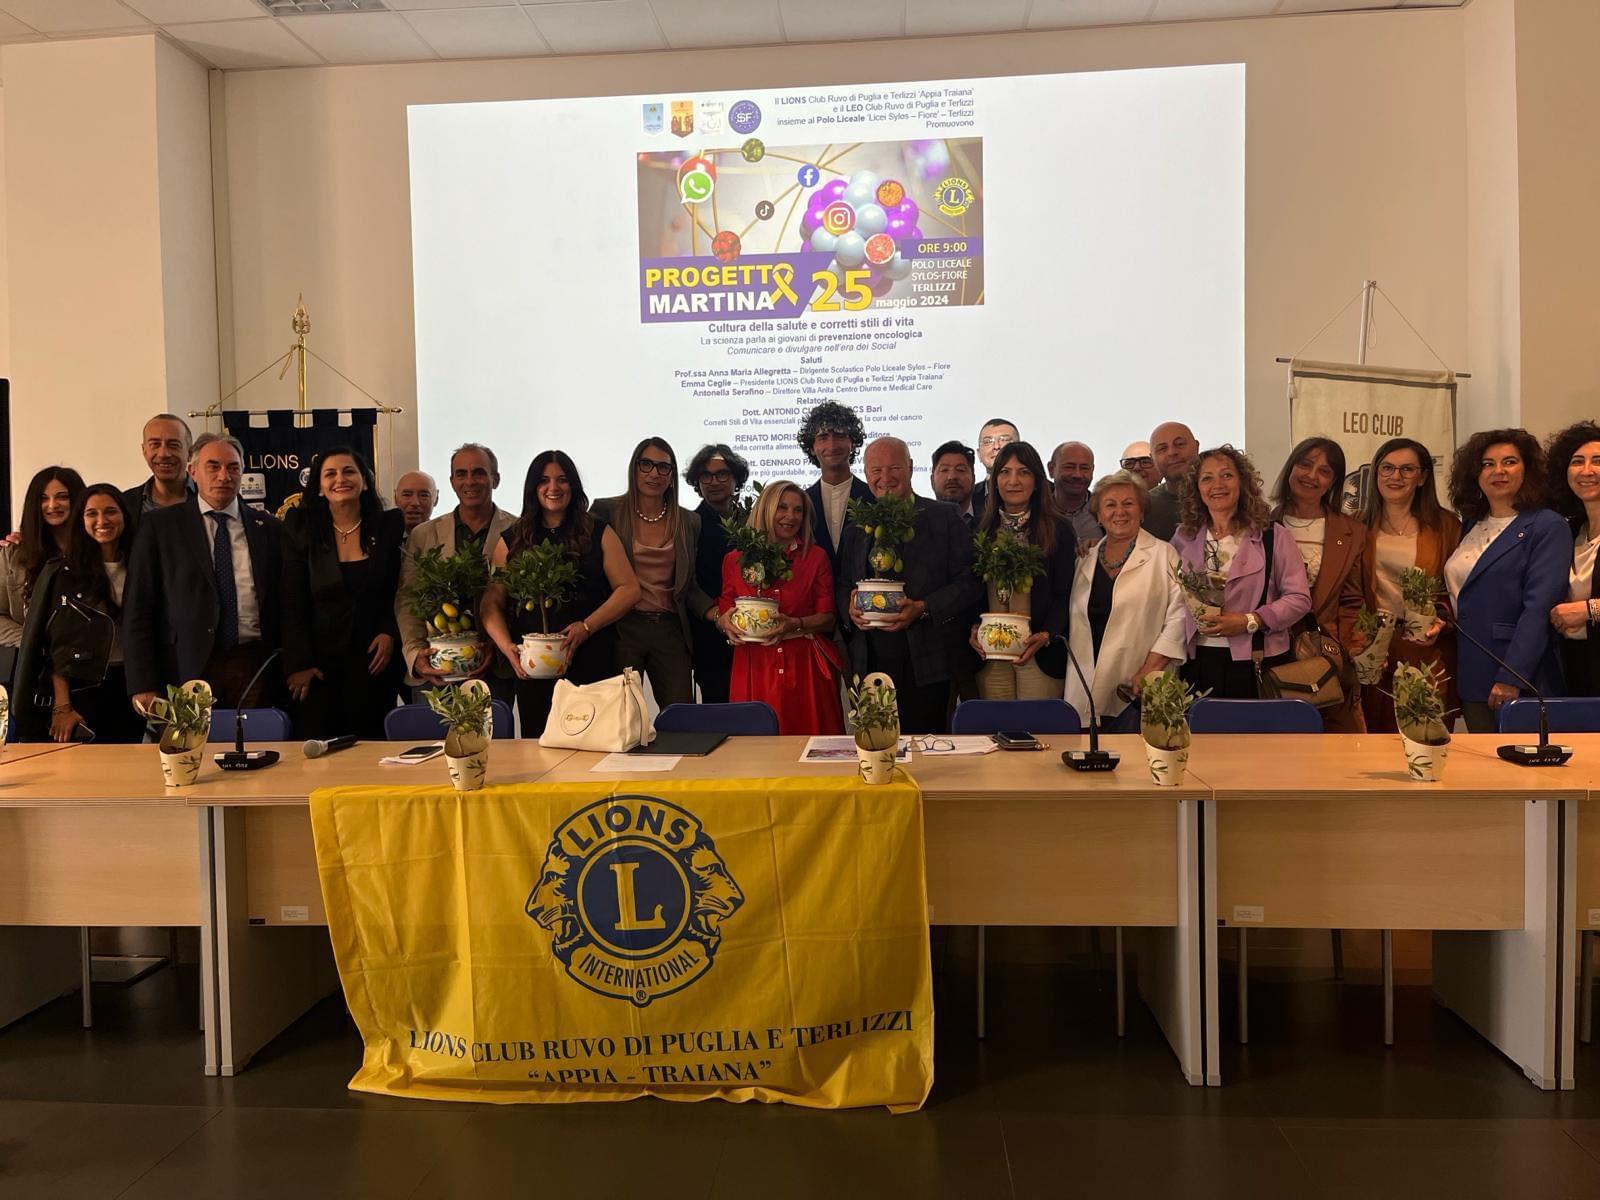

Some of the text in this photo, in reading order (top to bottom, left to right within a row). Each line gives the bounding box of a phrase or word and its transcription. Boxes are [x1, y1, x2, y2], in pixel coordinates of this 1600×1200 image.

[781, 97, 807, 105] LIONS
[809, 95, 826, 103] Club
[828, 95, 848, 103] Ruvo
[849, 94, 857, 102] di
[858, 93, 882, 103] Puglia
[890, 91, 917, 99] Terlizzi
[846, 104, 863, 112] LEO
[865, 103, 883, 111] Club
[885, 102, 905, 111] Ruvo
[915, 100, 939, 110] Puglia
[948, 99, 974, 107] Terlizzi
[777, 117, 806, 126] insieme
[816, 116, 835, 124] Polo
[837, 114, 865, 122] Liceale
[888, 112, 910, 121] Sylos
[948, 109, 974, 118] Terlizzi
[926, 119, 975, 129] Promuovono
[943, 177, 967, 188] LIONS
[918, 242, 967, 253] ORE 9:00
[911, 258, 972, 270] POLO LICEALE
[911, 270, 968, 281] SYLOS-FIORE
[809, 269, 873, 312] 25
[912, 282, 956, 292] TERLIZZI
[649, 290, 776, 315] MARTINA
[875, 294, 949, 309] maggio 2024
[708, 316, 915, 333] Cultura della salute e corretti stili di vita
[700, 330, 923, 346] La scienza parla ai giovani di prevenzione oncologica
[727, 346, 776, 355] Comunicare
[785, 344, 823, 355] divulgare
[871, 341, 897, 351] Social
[800, 356, 823, 364] Saluti
[674, 369, 707, 378] Prof.ssa
[708, 369, 729, 377] Anna
[730, 368, 752, 376] Maria
[753, 367, 791, 377] Allegretta
[800, 366, 829, 376] Dirigente
[830, 365, 864, 374] Scolastico
[865, 364, 881, 372] Polo
[882, 364, 906, 372] Liceale
[907, 363, 926, 372] Sylos
[933, 362, 951, 370] Fiore
[681, 380, 705, 388] Emma
[707, 379, 732, 389] Ceglie
[740, 378, 775, 386] Presidente
[776, 377, 799, 385] LIONS
[800, 376, 816, 385] Club
[816, 376, 834, 384] Ruvo
[843, 375, 864, 385] Puglia
[692, 388, 730, 397] Antonella
[732, 387, 765, 396] Serafino
[772, 386, 801, 395] Direttore
[817, 386, 834, 394] Anita
[835, 385, 858, 393] Centro
[889, 383, 915, 391] Medical
[742, 408, 761, 417] Dott.
[762, 407, 800, 416] ANTONIO
[866, 405, 883, 413] Bari
[763, 416, 796, 425] essenziali
[1343, 411, 1404, 437] LEO CLUB
[735, 433, 769, 442] RENATO
[771, 433, 799, 442] MORIS
[249, 454, 299, 470] LIONS
[759, 458, 801, 467] GENNARO
[566, 804, 690, 851] LIONS
[609, 861, 667, 931] L
[578, 949, 701, 989] INTERNATIONAL
[409, 1010, 913, 1063] LIONS CLUB RUVO DI PUGLIA E TERLIZZI
